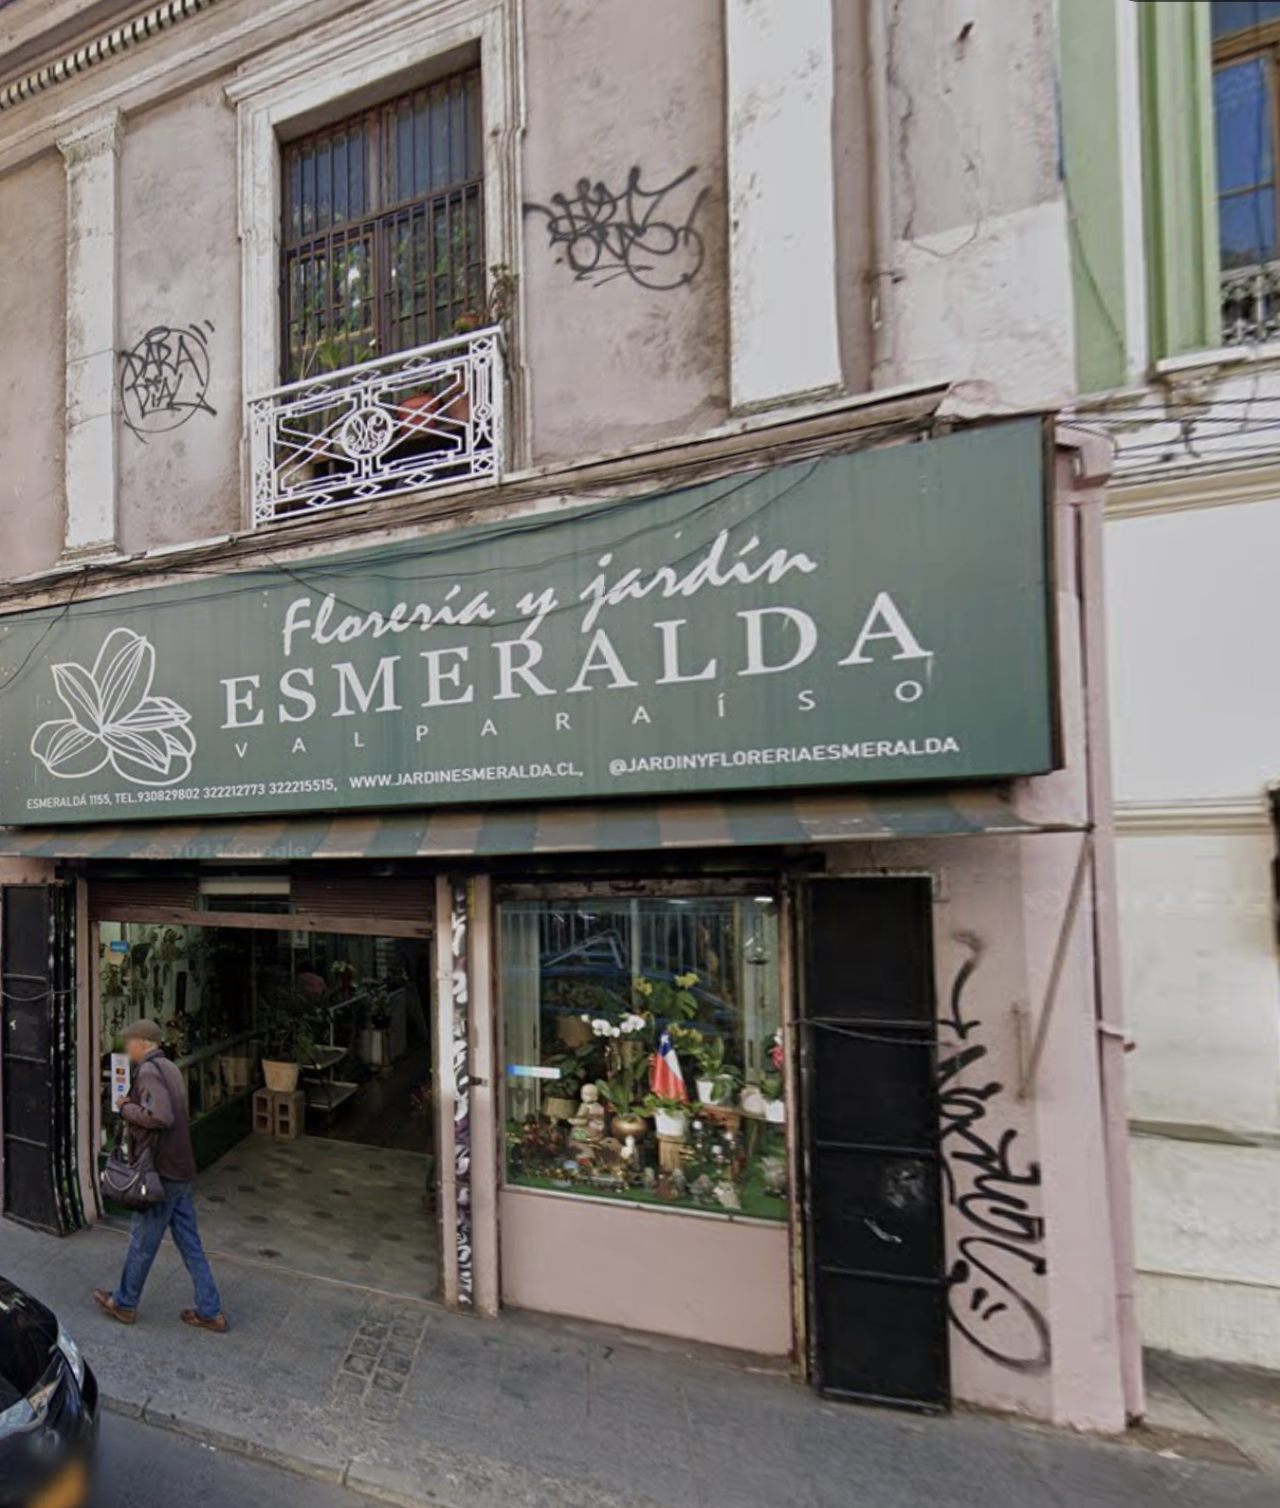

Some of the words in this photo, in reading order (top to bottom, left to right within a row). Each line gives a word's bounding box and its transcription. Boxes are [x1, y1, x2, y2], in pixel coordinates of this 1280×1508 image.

[282, 584, 496, 656] Florería
[516, 586, 558, 643] y
[580, 528, 817, 632] jardín
[220, 591, 933, 729] ESMERALDA
[90, 794, 113, 806] 1155,
[203, 783, 266, 799] 322212773
[609, 736, 960, 776] @JARDINYFLORERIAESMERALDA
